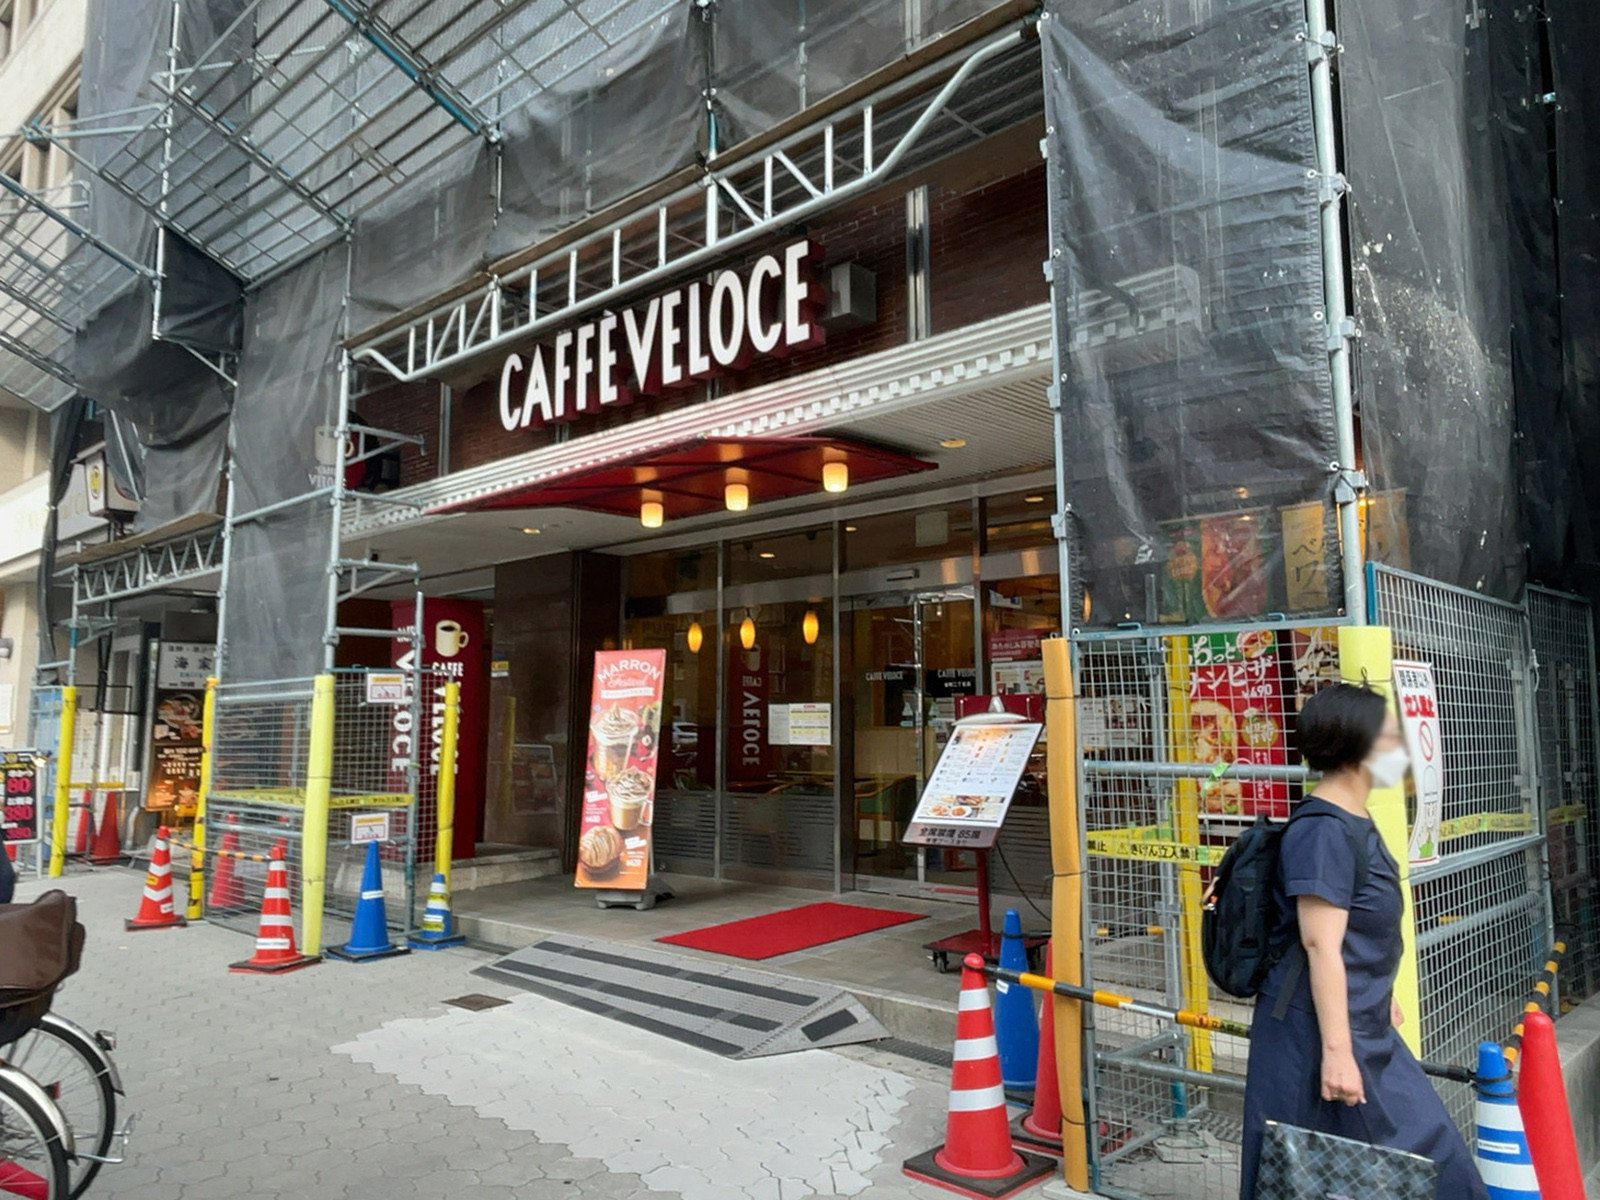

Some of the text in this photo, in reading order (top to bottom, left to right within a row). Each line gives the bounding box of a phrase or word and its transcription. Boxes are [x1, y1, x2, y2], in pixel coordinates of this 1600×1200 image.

[622, 239, 810, 394] VELOCE
[597, 659, 661, 684] MARRON
[1189, 636, 1236, 666] ちっと
[391, 649, 415, 772] VEOCE
